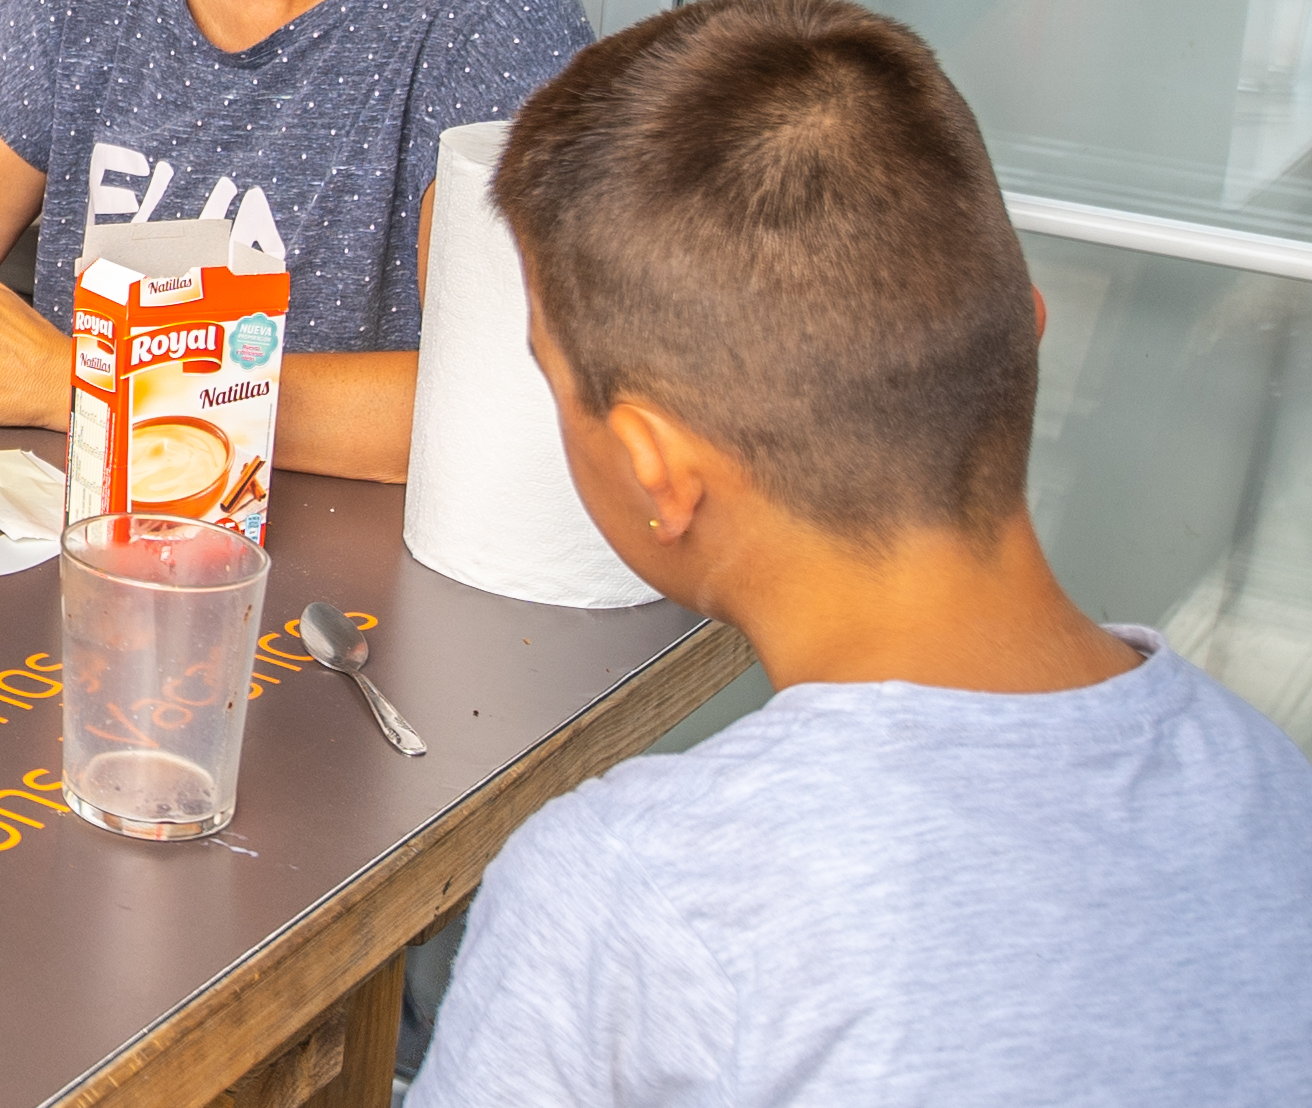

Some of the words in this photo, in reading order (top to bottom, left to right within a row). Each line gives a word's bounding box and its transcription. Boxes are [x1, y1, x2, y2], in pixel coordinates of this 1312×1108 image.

[148, 278, 193, 294] Natillas
[75, 311, 114, 339] Royal
[239, 323, 272, 337] NUEVA
[130, 325, 217, 366] Royal
[80, 352, 111, 373] Natillas
[199, 380, 271, 409] Natillas
